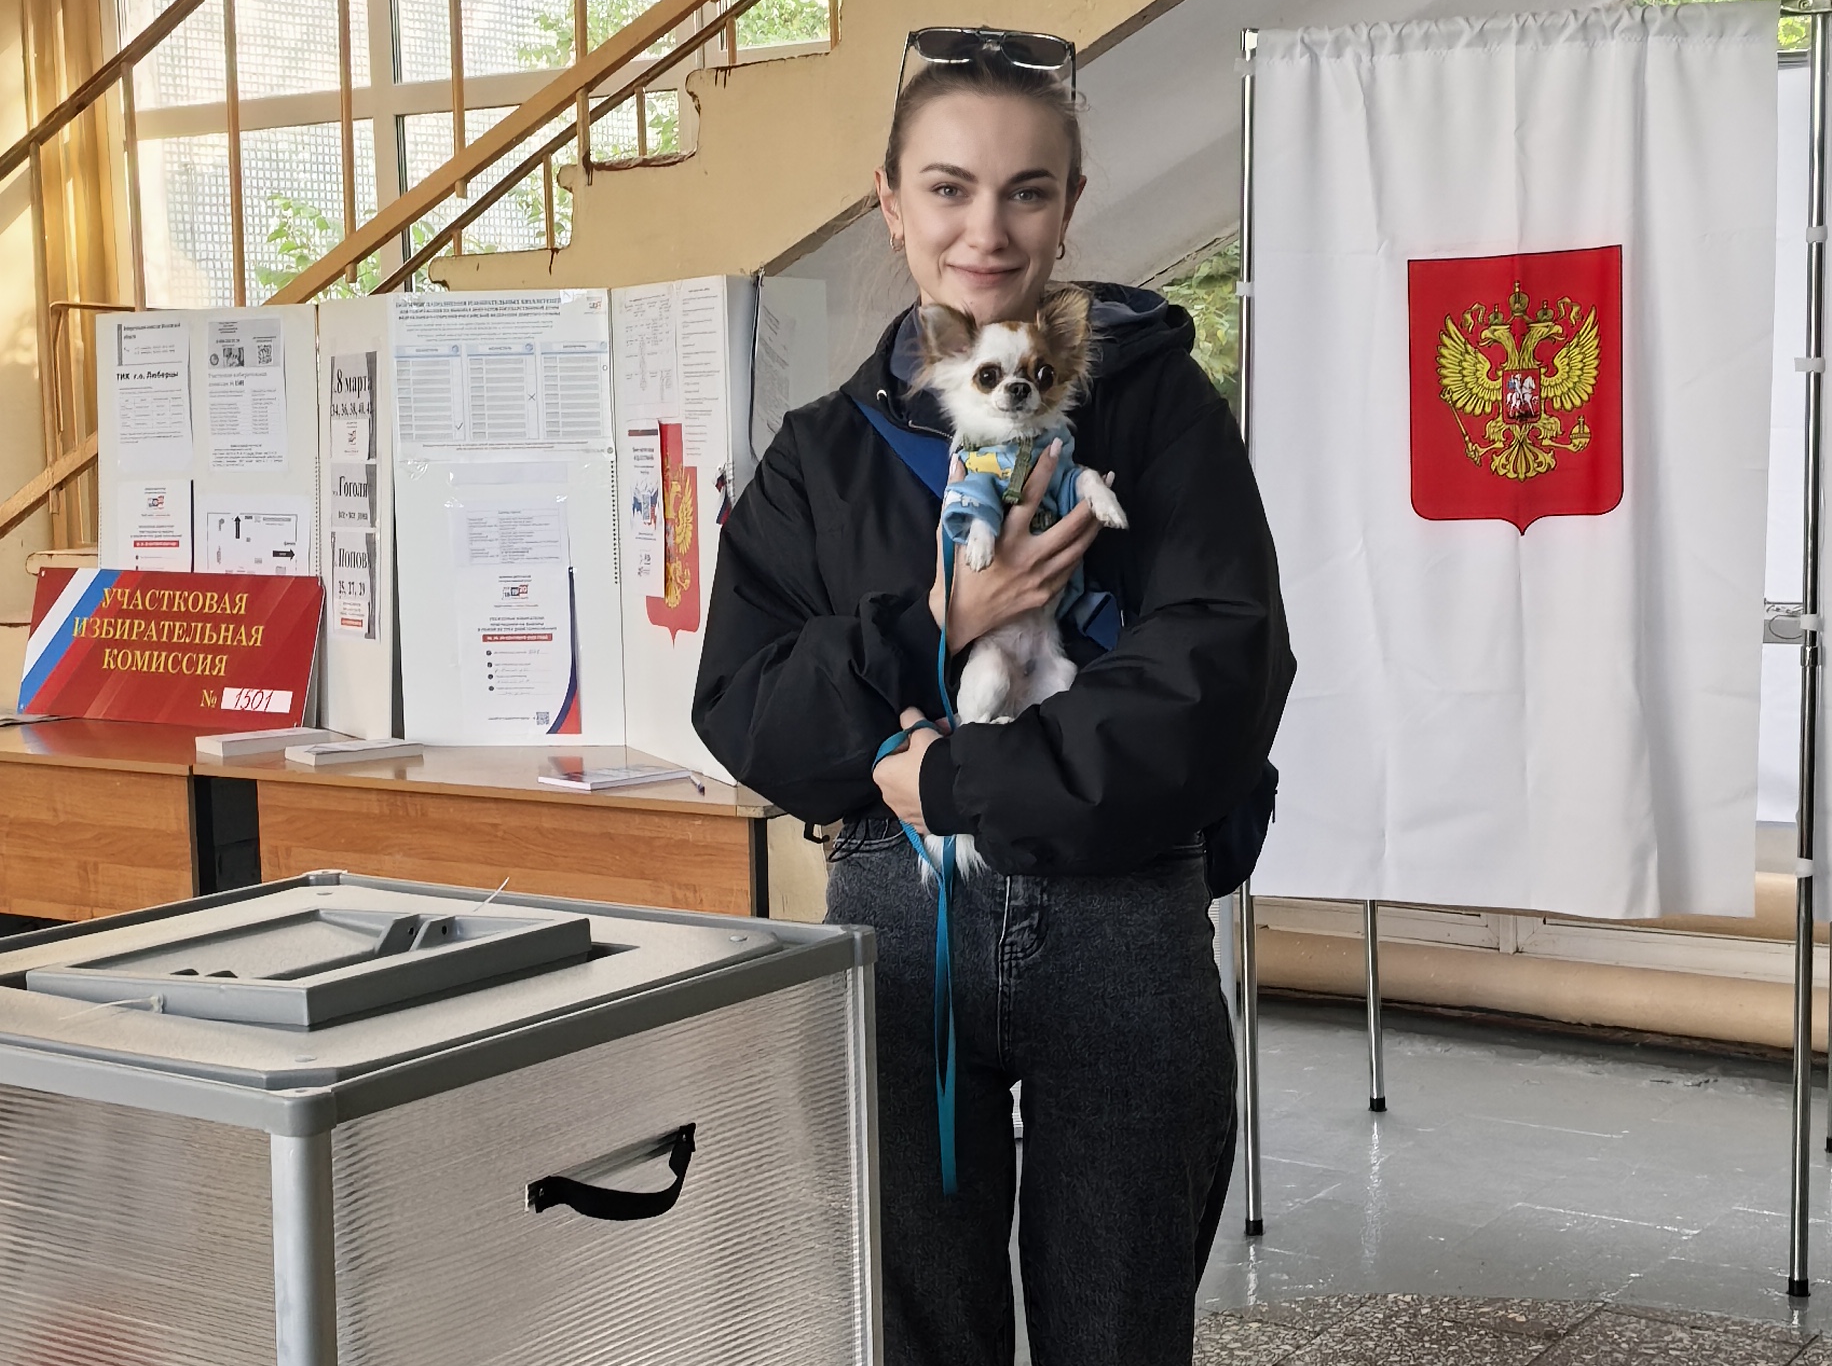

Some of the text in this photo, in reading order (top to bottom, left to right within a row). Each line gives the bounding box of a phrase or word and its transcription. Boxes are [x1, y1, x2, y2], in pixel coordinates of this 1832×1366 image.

[102, 588, 248, 614] УЧАСТКОВАЯ
[73, 617, 264, 646] ИЗБИРАТЕЛЬНАЯ
[102, 649, 228, 676] КОМИССИЯ
[200, 688, 275, 711] № 1501
